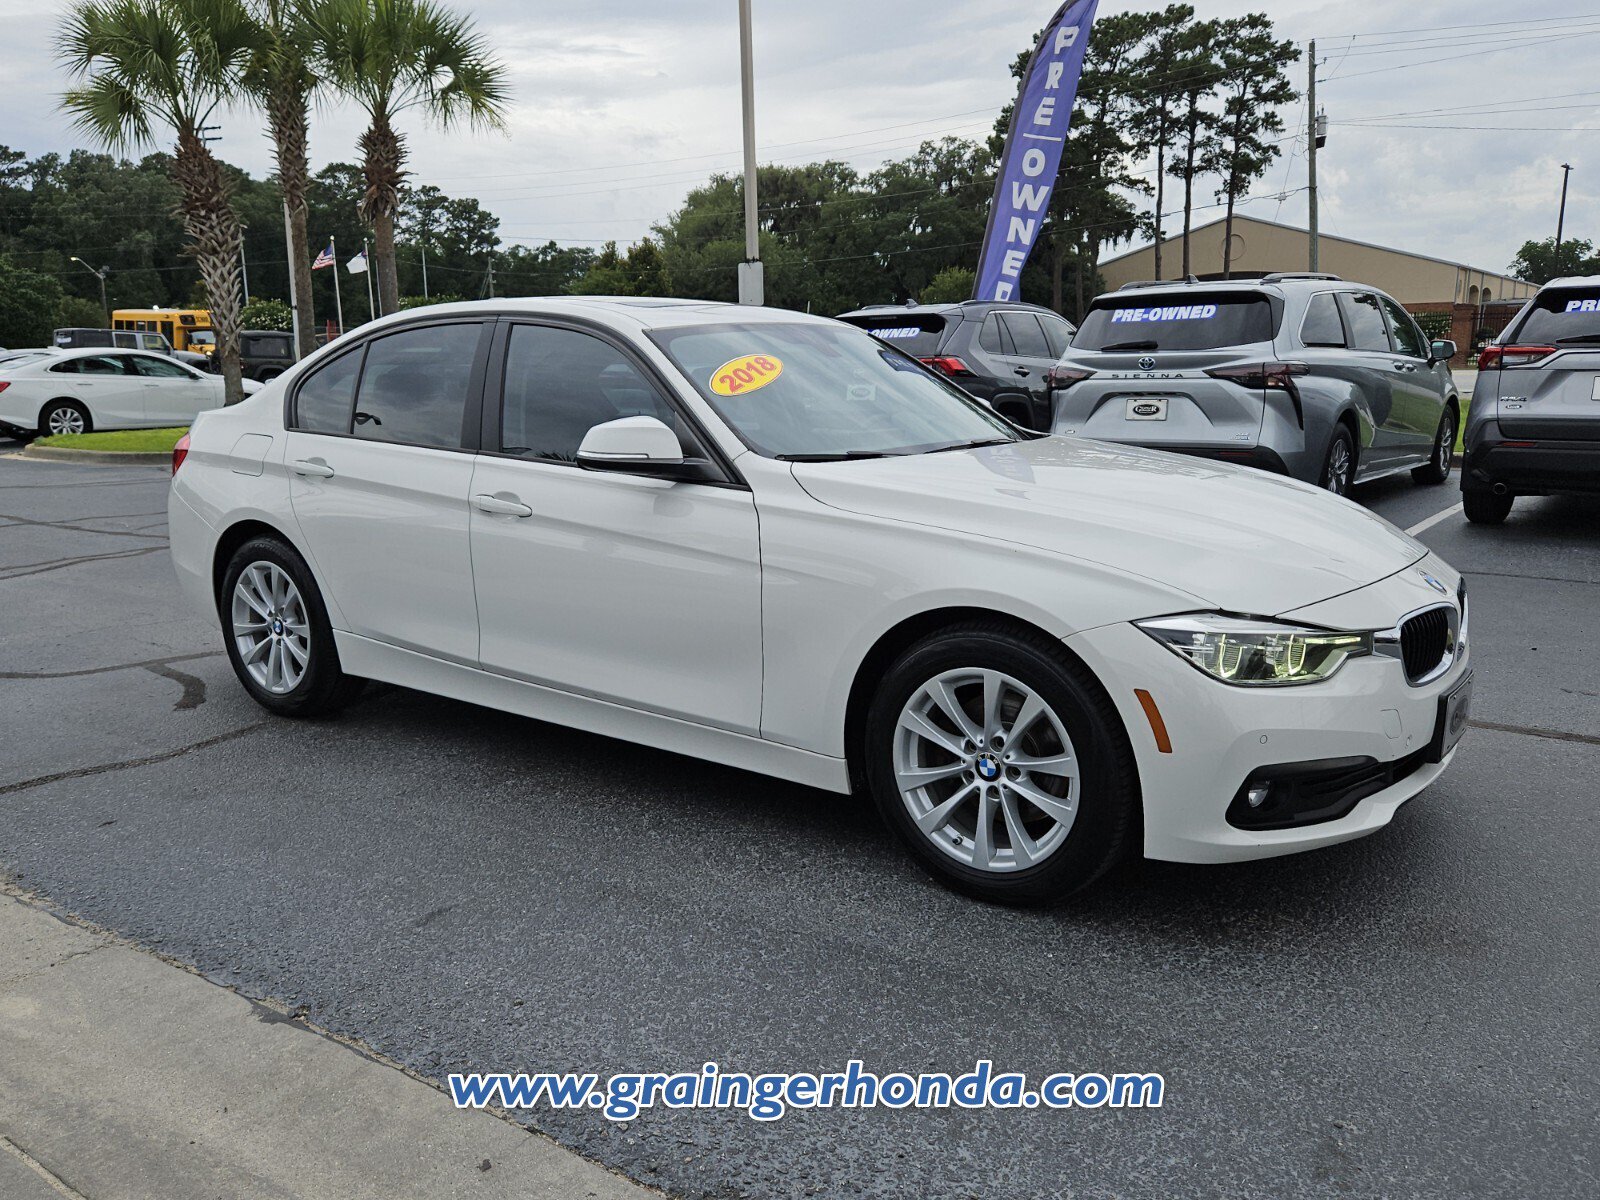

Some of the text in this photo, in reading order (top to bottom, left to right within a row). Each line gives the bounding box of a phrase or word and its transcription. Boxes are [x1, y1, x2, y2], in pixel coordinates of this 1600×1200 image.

[1111, 304, 1217, 322] PRE-OWNED
[1565, 299, 1600, 312] PR
[719, 356, 775, 393] 2018
